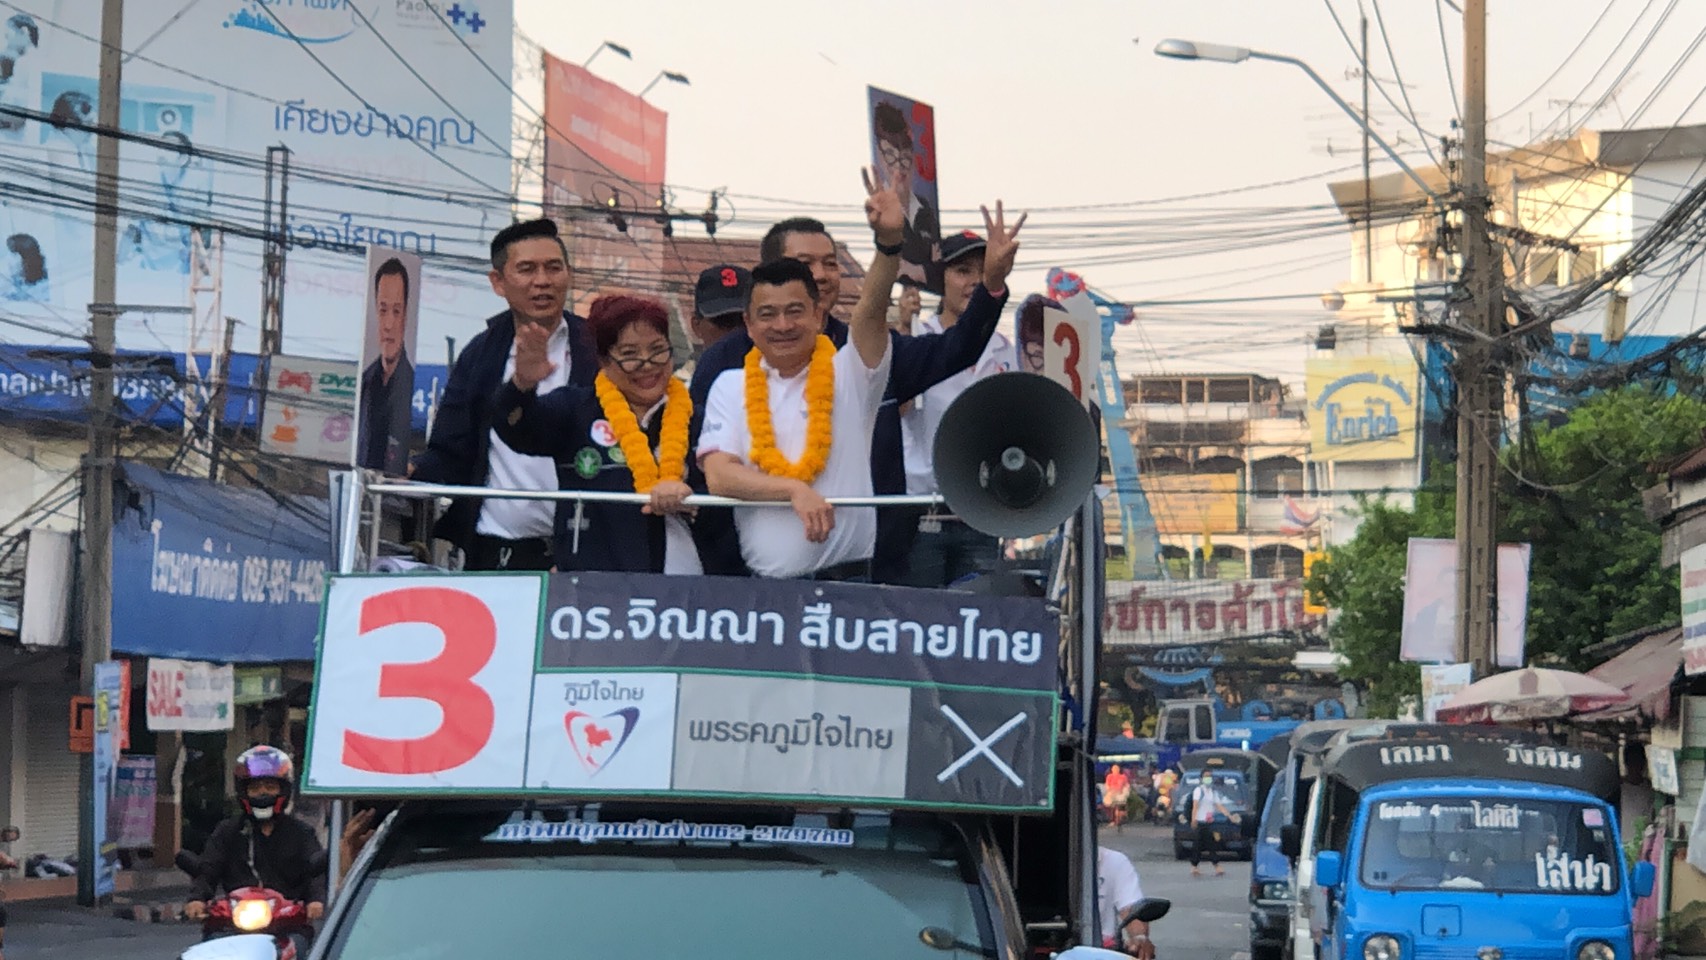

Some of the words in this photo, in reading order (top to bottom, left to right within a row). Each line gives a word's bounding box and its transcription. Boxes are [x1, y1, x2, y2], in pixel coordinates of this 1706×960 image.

[912, 101, 936, 182] 3
[721, 268, 738, 287] 3
[1053, 321, 1082, 400] 3
[594, 423, 619, 443] 3
[1325, 402, 1399, 446] Enrich
[550, 599, 784, 645] ดร.จิณณา
[800, 601, 1042, 664] สืบสายไทย
[341, 586, 497, 775] 3
[564, 680, 645, 705] ภูมิใจไทย
[689, 715, 893, 753] พรรคภูมิใจไทย
[1536, 850, 1611, 891] เสนา
